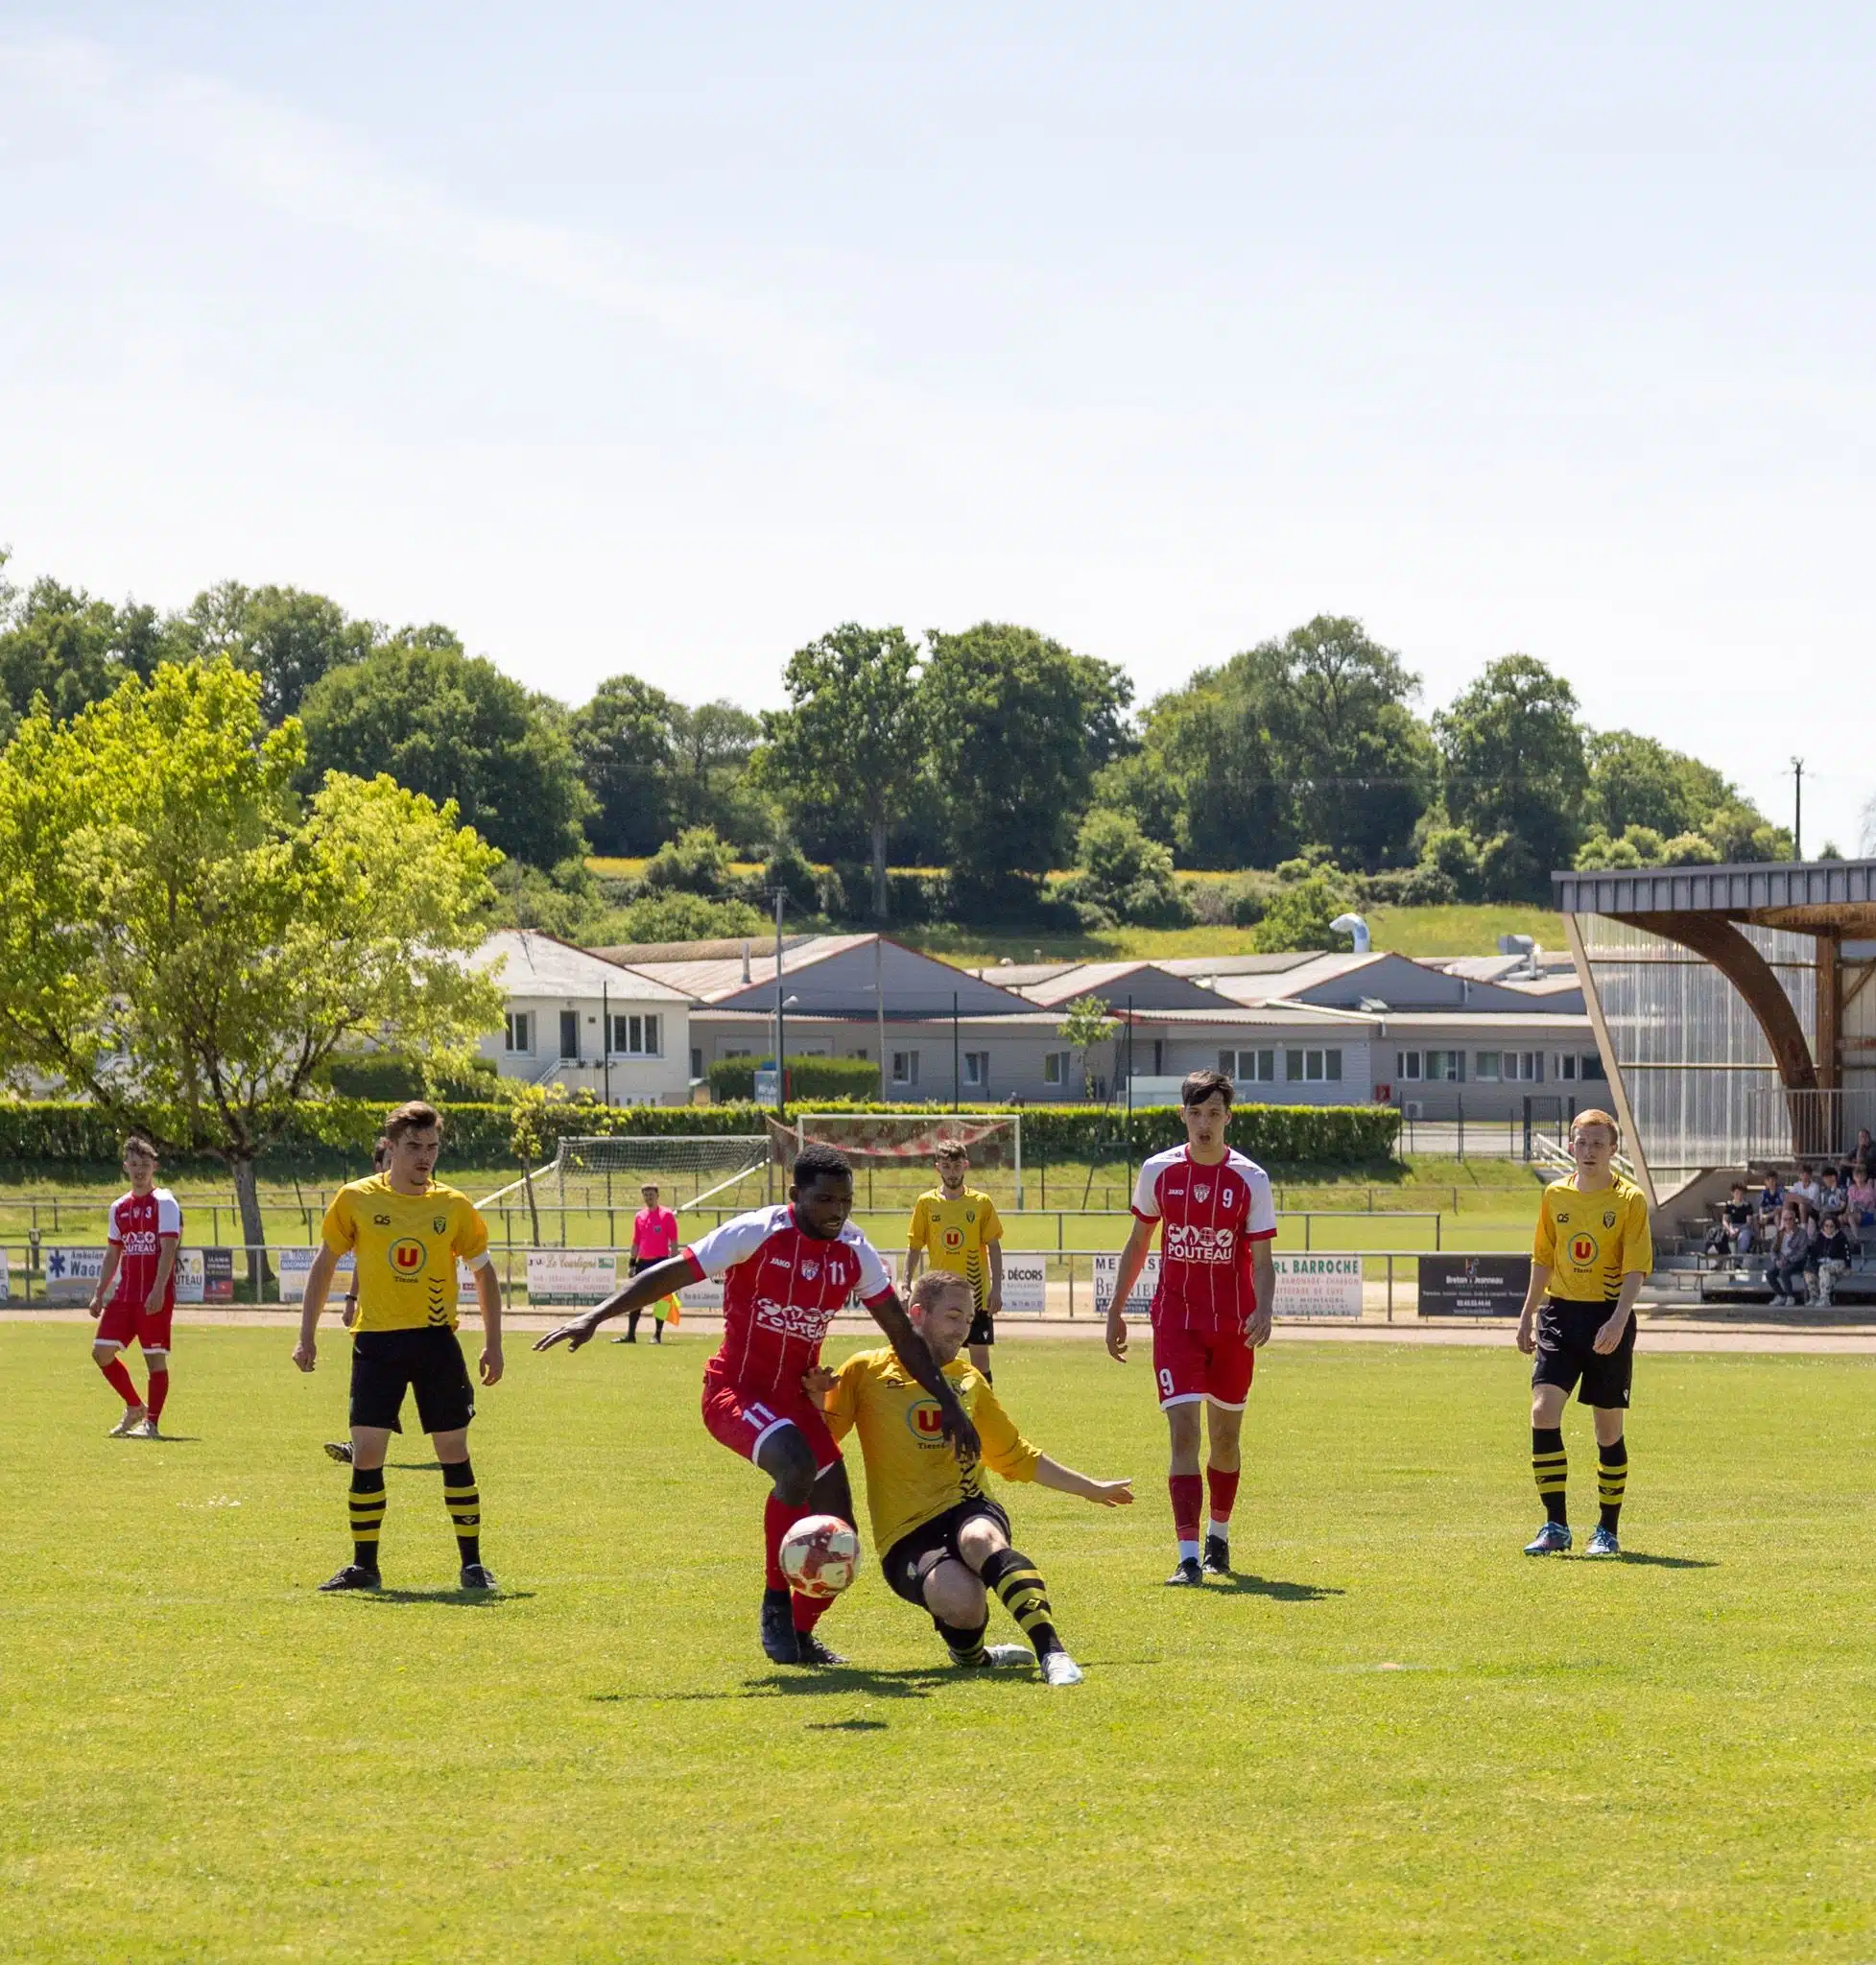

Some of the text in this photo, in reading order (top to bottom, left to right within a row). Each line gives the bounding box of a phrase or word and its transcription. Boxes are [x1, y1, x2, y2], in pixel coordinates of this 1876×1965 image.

[1223, 1189, 1233, 1209] 9
[145, 1206, 153, 1219] 3
[947, 1233, 959, 1245] U
[397, 1247, 418, 1267] U
[1168, 1243, 1232, 1261] POUTEAU
[1575, 1242, 1591, 1259] U
[770, 1257, 792, 1268] JAKO
[1272, 1259, 1359, 1274] RL BARROCHE
[829, 1261, 846, 1286] 11
[1008, 1267, 1043, 1282] DÉCORS
[1159, 1368, 1175, 1396] 9
[741, 1402, 776, 1431] 11
[918, 1409, 942, 1432] U
